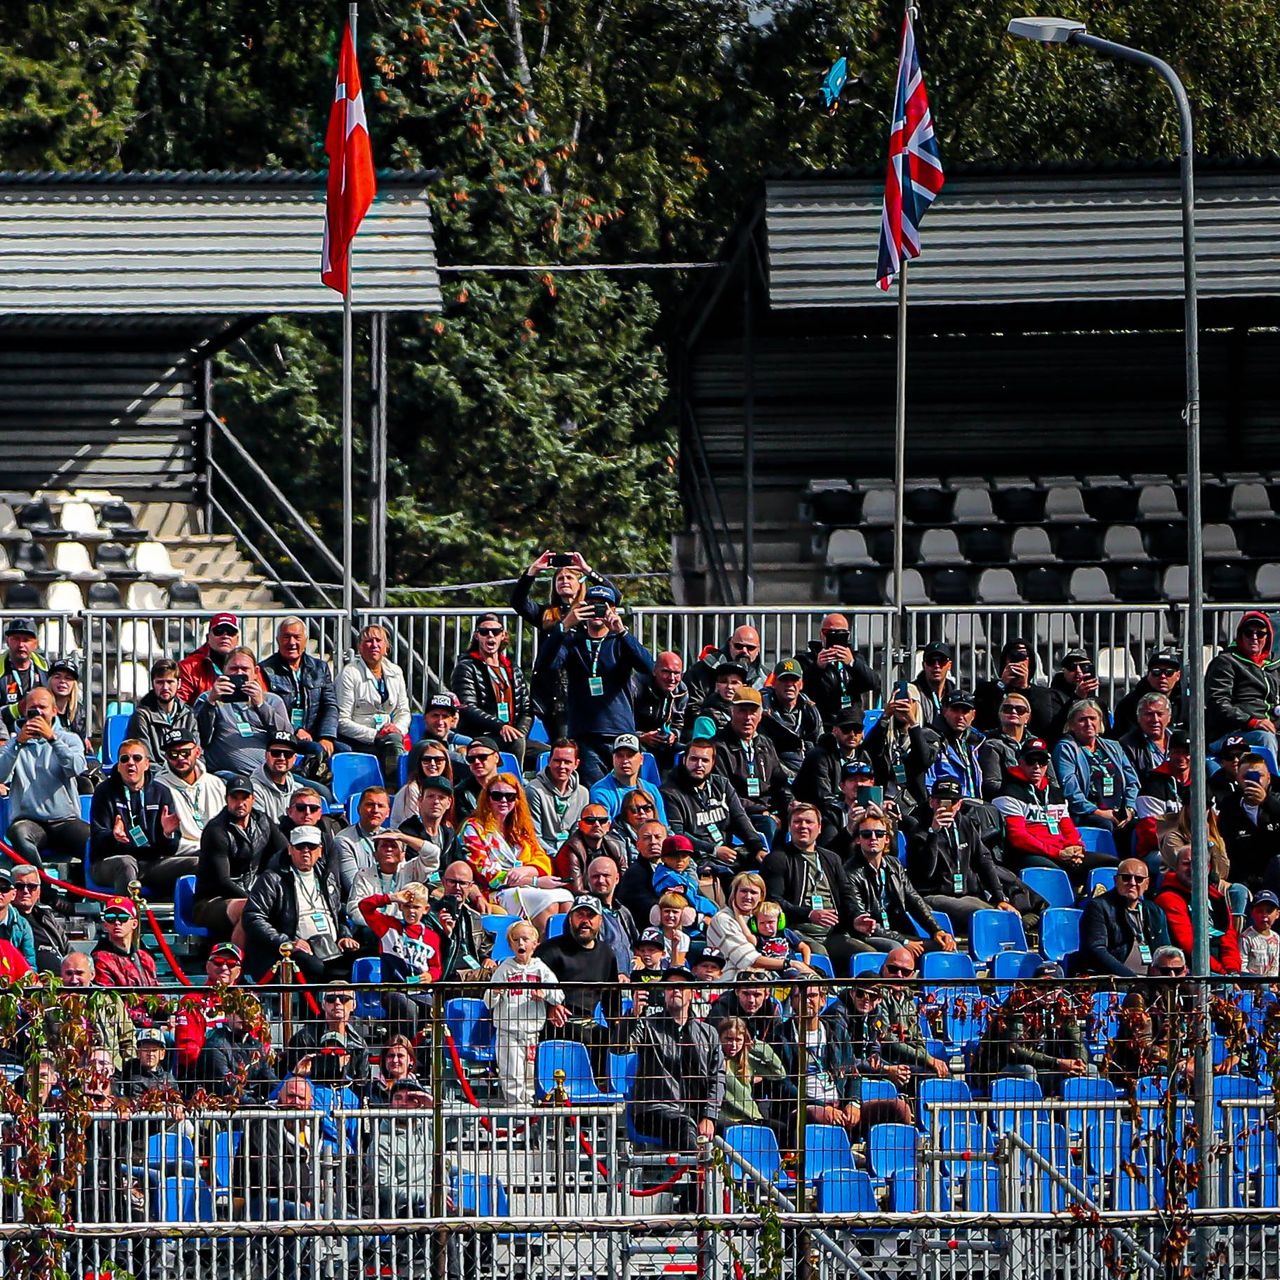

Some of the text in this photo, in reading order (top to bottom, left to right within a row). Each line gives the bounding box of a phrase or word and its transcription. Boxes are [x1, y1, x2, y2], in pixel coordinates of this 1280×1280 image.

[276, 732, 291, 741] RX
[619, 737, 633, 745] RX
[578, 896, 596, 906] RX
